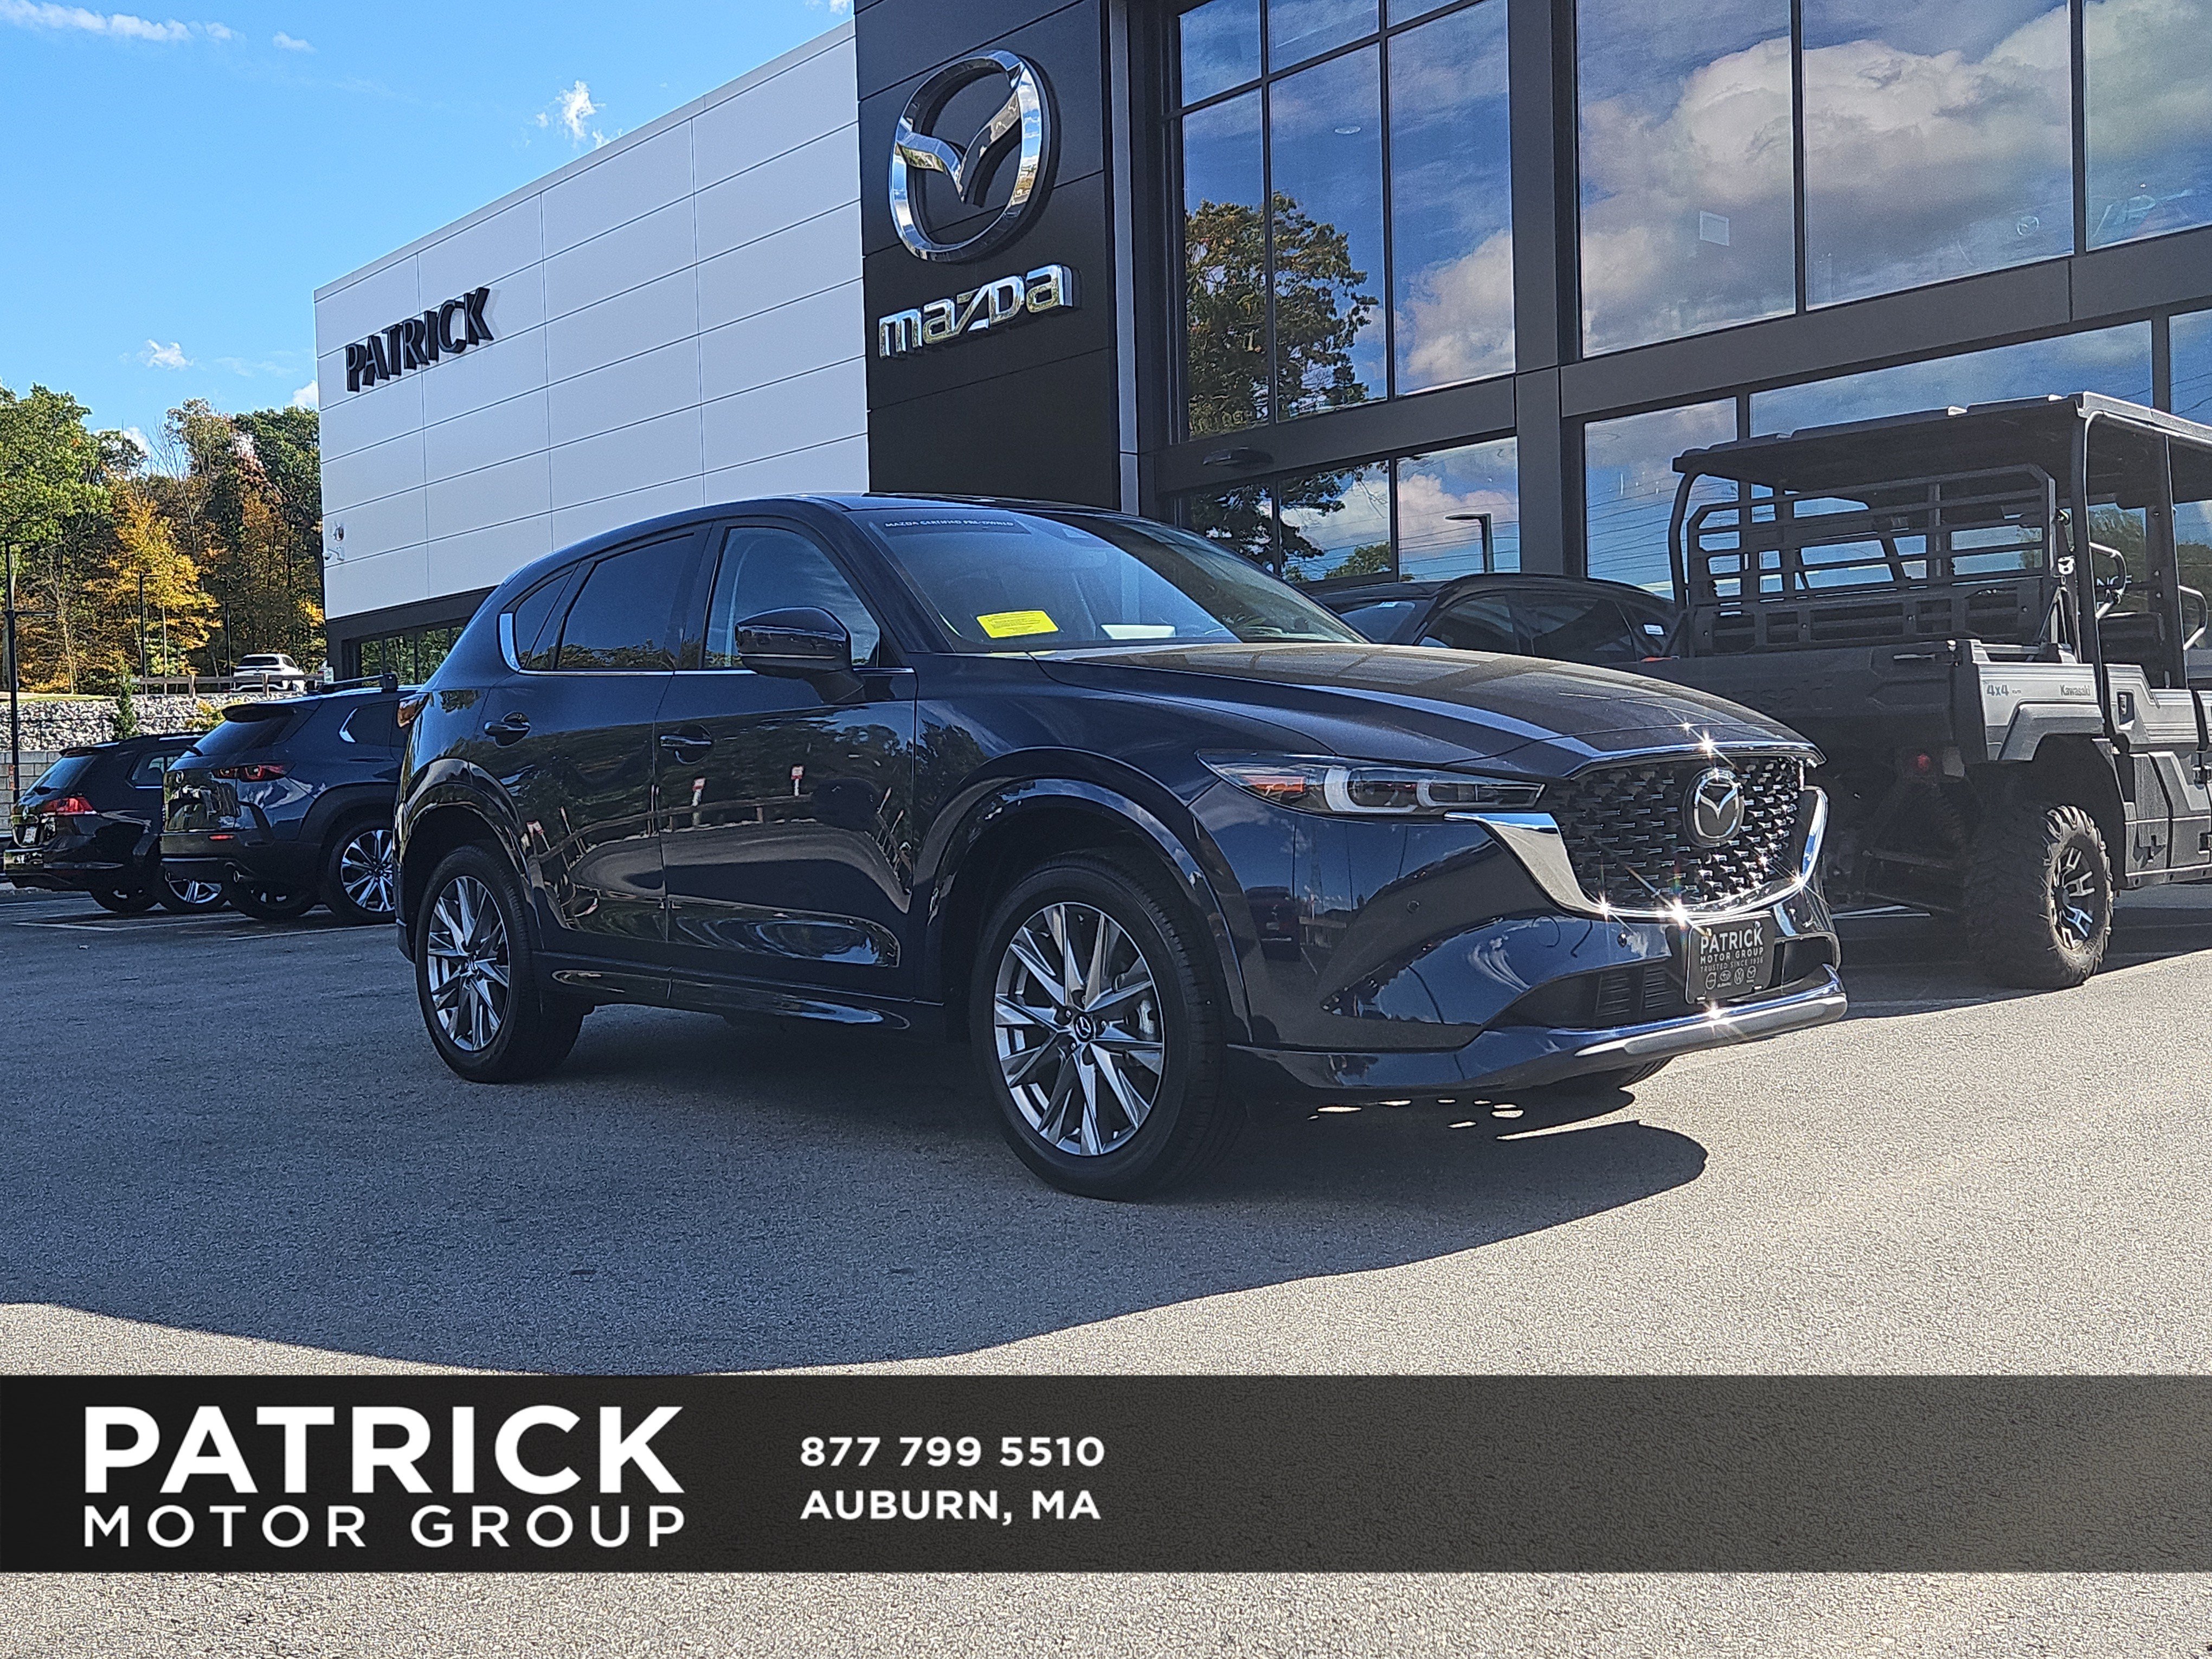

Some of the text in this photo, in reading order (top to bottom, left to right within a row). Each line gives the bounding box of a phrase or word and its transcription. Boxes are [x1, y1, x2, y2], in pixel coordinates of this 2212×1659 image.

[345, 287, 494, 393] PATRICK
[1986, 684, 2009, 696] 4x4
[2060, 684, 2091, 696] Kawasaki
[1700, 927, 1764, 955] PATRICK
[1700, 947, 1764, 964] MOTOR GROUP
[1700, 962, 1728, 973] TRUSTED
[1730, 959, 1748, 968] SINCE
